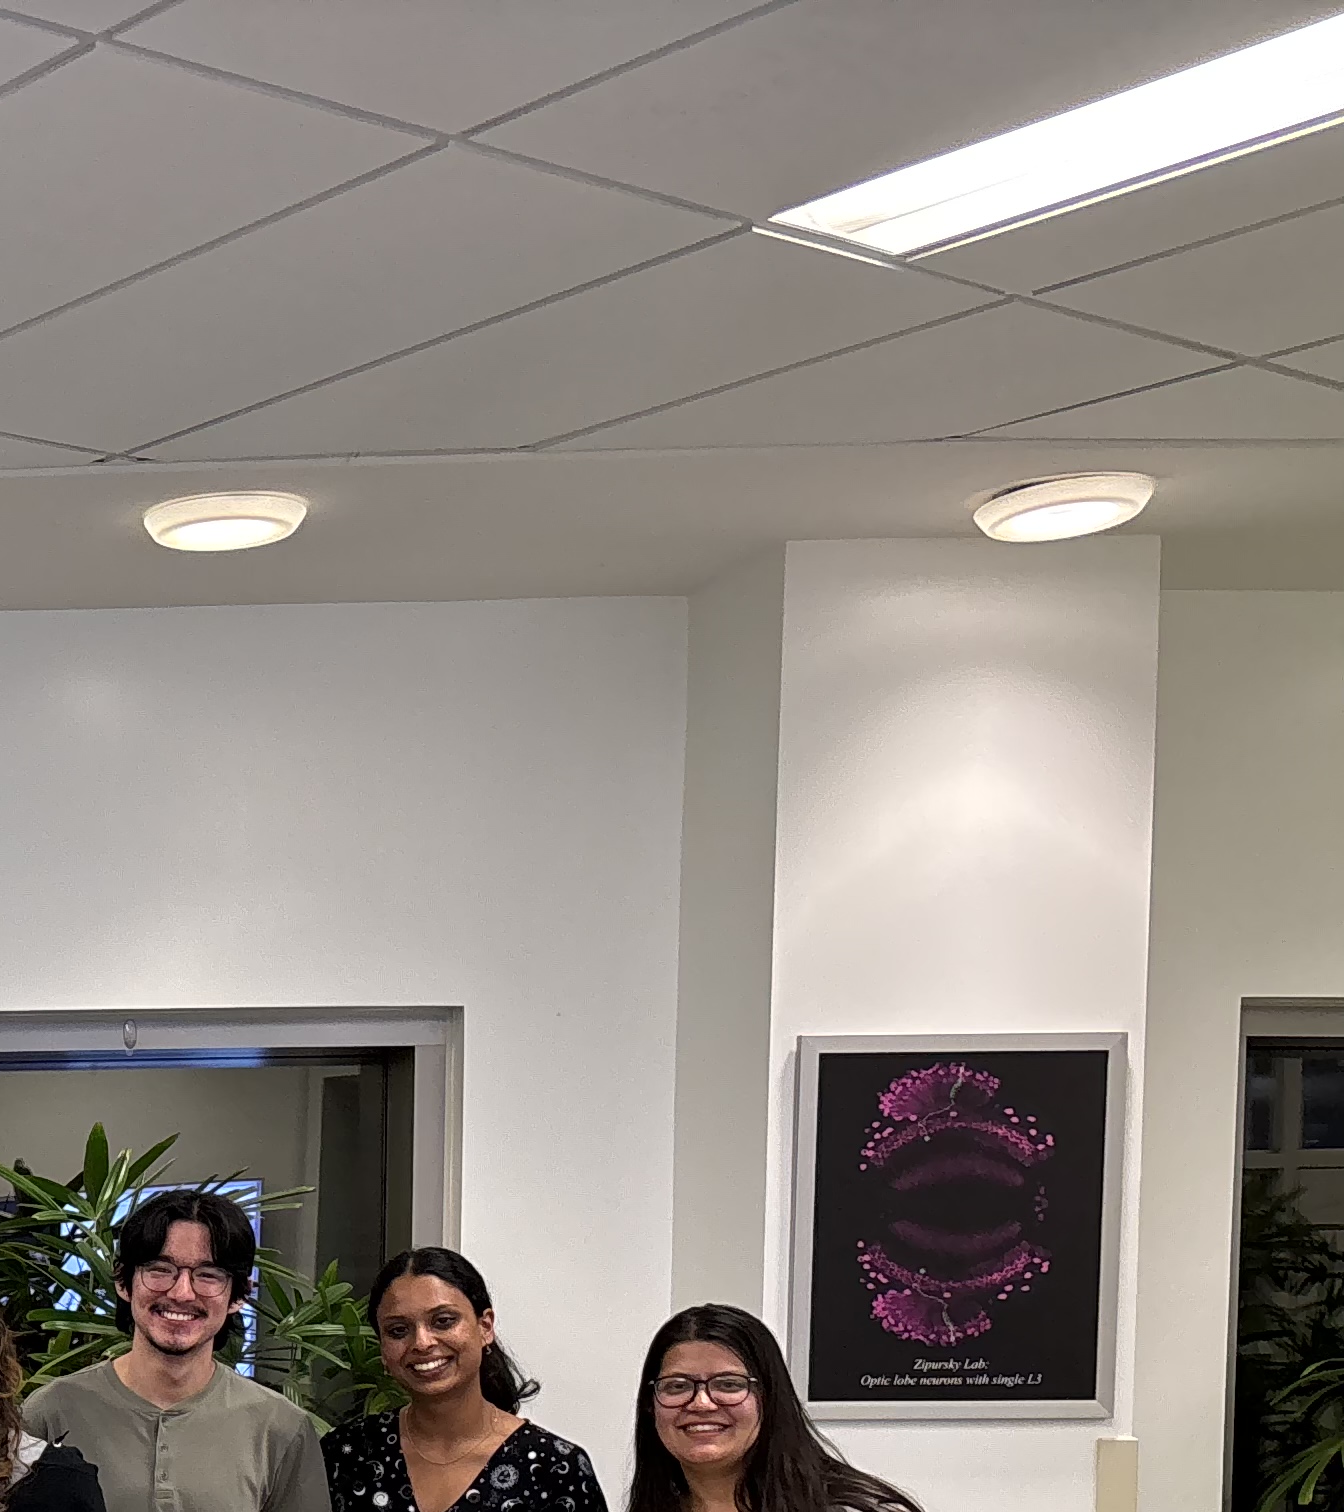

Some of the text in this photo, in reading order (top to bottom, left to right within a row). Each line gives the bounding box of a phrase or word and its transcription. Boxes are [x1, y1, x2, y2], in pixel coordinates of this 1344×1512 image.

[913, 1358, 990, 1373] Zipursky Lab:
[860, 1373, 1043, 1389] Optic lobe neurons with single L3
